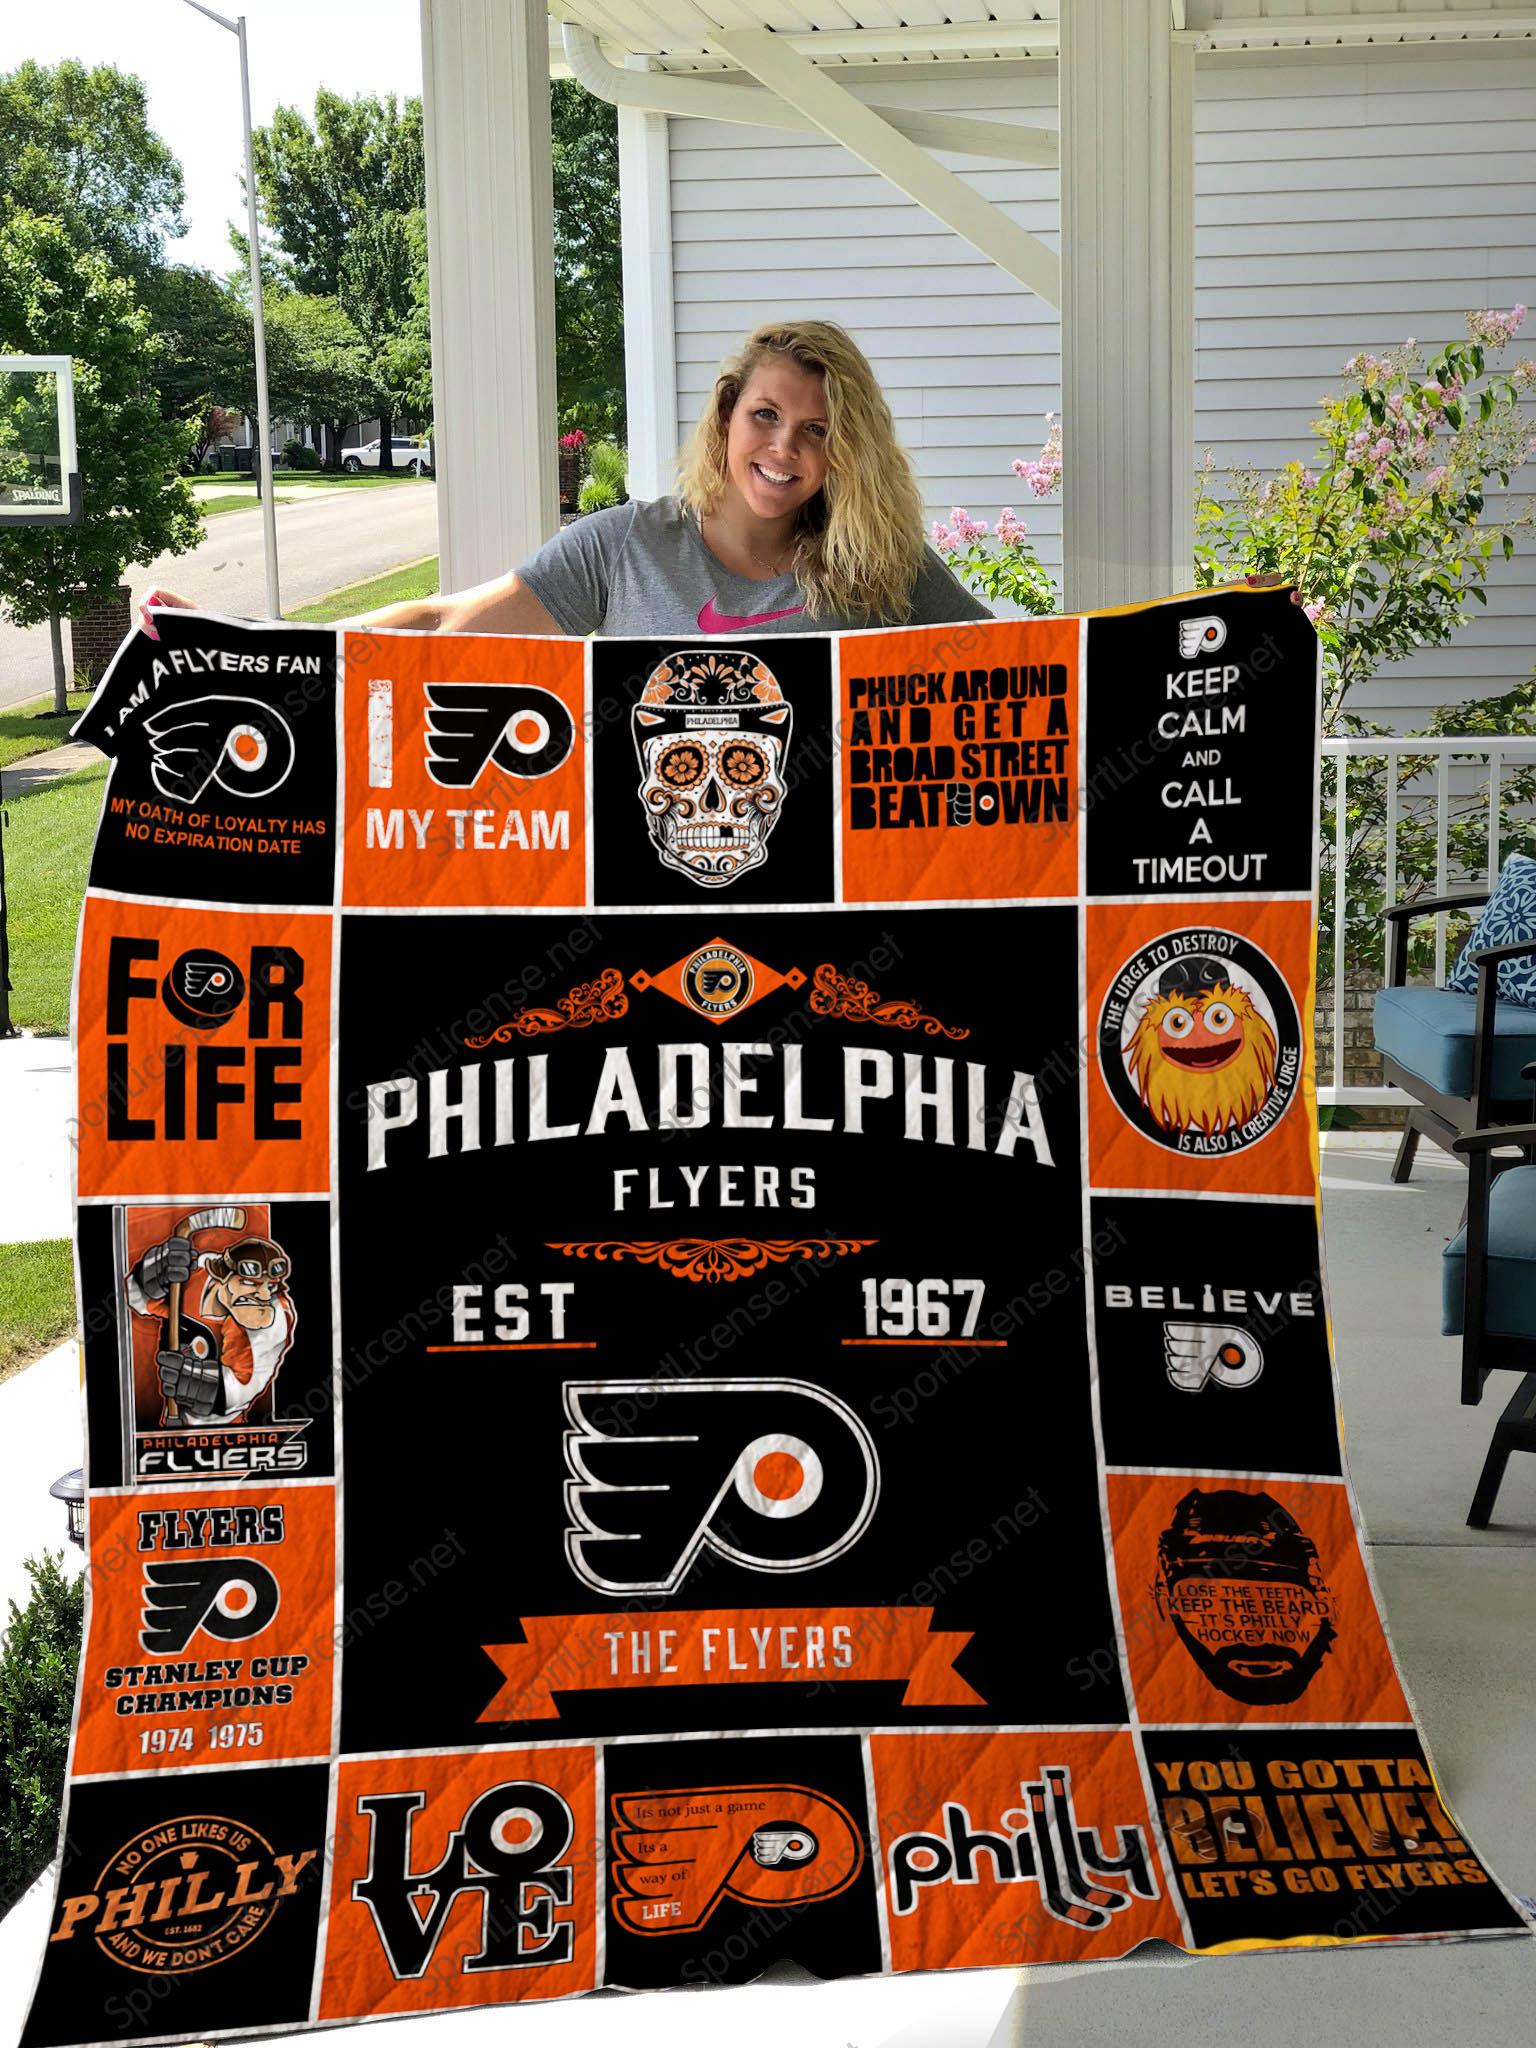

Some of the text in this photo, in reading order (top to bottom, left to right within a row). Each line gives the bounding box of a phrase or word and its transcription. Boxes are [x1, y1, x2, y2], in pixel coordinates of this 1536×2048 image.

[12, 489, 61, 502] SPALDING
[104, 648, 321, 737] I AM A FLYERS FAN
[849, 664, 1067, 709] PHUCK AROUND
[1166, 665, 1240, 700] KEEP
[368, 679, 392, 788] I
[850, 698, 1069, 746] AND GET A
[1157, 704, 1246, 739] CALM
[850, 739, 1069, 783] BROAD STREET
[1181, 749, 1222, 768] AND
[1161, 778, 1242, 809] CALL
[110, 797, 326, 835] MY OATH OF LOYALTY HAS
[366, 808, 569, 849] MY TEAM
[1188, 817, 1213, 845] A
[125, 823, 301, 854] NO EXPIRATION DATE
[1132, 853, 1267, 884] TIMEOUT
[689, 950, 746, 974] PHILADELPHIA
[1104, 934, 1239, 1030] THE URGE TO DESTROY
[701, 1000, 738, 1011] FLYERS
[106, 1043, 302, 1141] LIFE
[365, 1042, 1056, 1172] PHILADELPHIA
[1178, 1045, 1298, 1153] IS ALSO A CREATIVE URGE
[613, 1166, 816, 1211] FLYERS
[451, 1277, 986, 1342] EST 1967
[1105, 1283, 1315, 1317] BELIEVE
[143, 1433, 279, 1449] PHILADELPHIA
[140, 1445, 303, 1473] FLYERS
[137, 1504, 285, 1552] FLYERS
[1167, 1598, 1330, 1616] KEEP THE BEARD
[1178, 1585, 1304, 1600] LOSE THE TEETH
[1197, 1629, 1310, 1643] HOCKEY NOW
[1199, 1614, 1301, 1629] IT'S PHILLY
[603, 1625, 853, 1676] THE FLYERS
[105, 1654, 308, 1688] STANLEY CUP
[115, 1684, 294, 1716] CHAMPIONS
[138, 1722, 264, 1755] 1974 1975
[1154, 1758, 1433, 1792] YOU GOTTA
[636, 1802, 766, 1818] Its not just a game
[1162, 1792, 1469, 1865] BELIEVE!
[115, 1823, 252, 1875] NO ONE LIKES US
[638, 1842, 668, 1854] Its a
[640, 1868, 688, 1885] way of
[1181, 1859, 1489, 1899] LET'S GO FLYERS
[49, 1849, 317, 1942] PHILLY
[642, 1902, 682, 1920] LIFE
[108, 1906, 264, 1967] AND WE DON'T CARE
